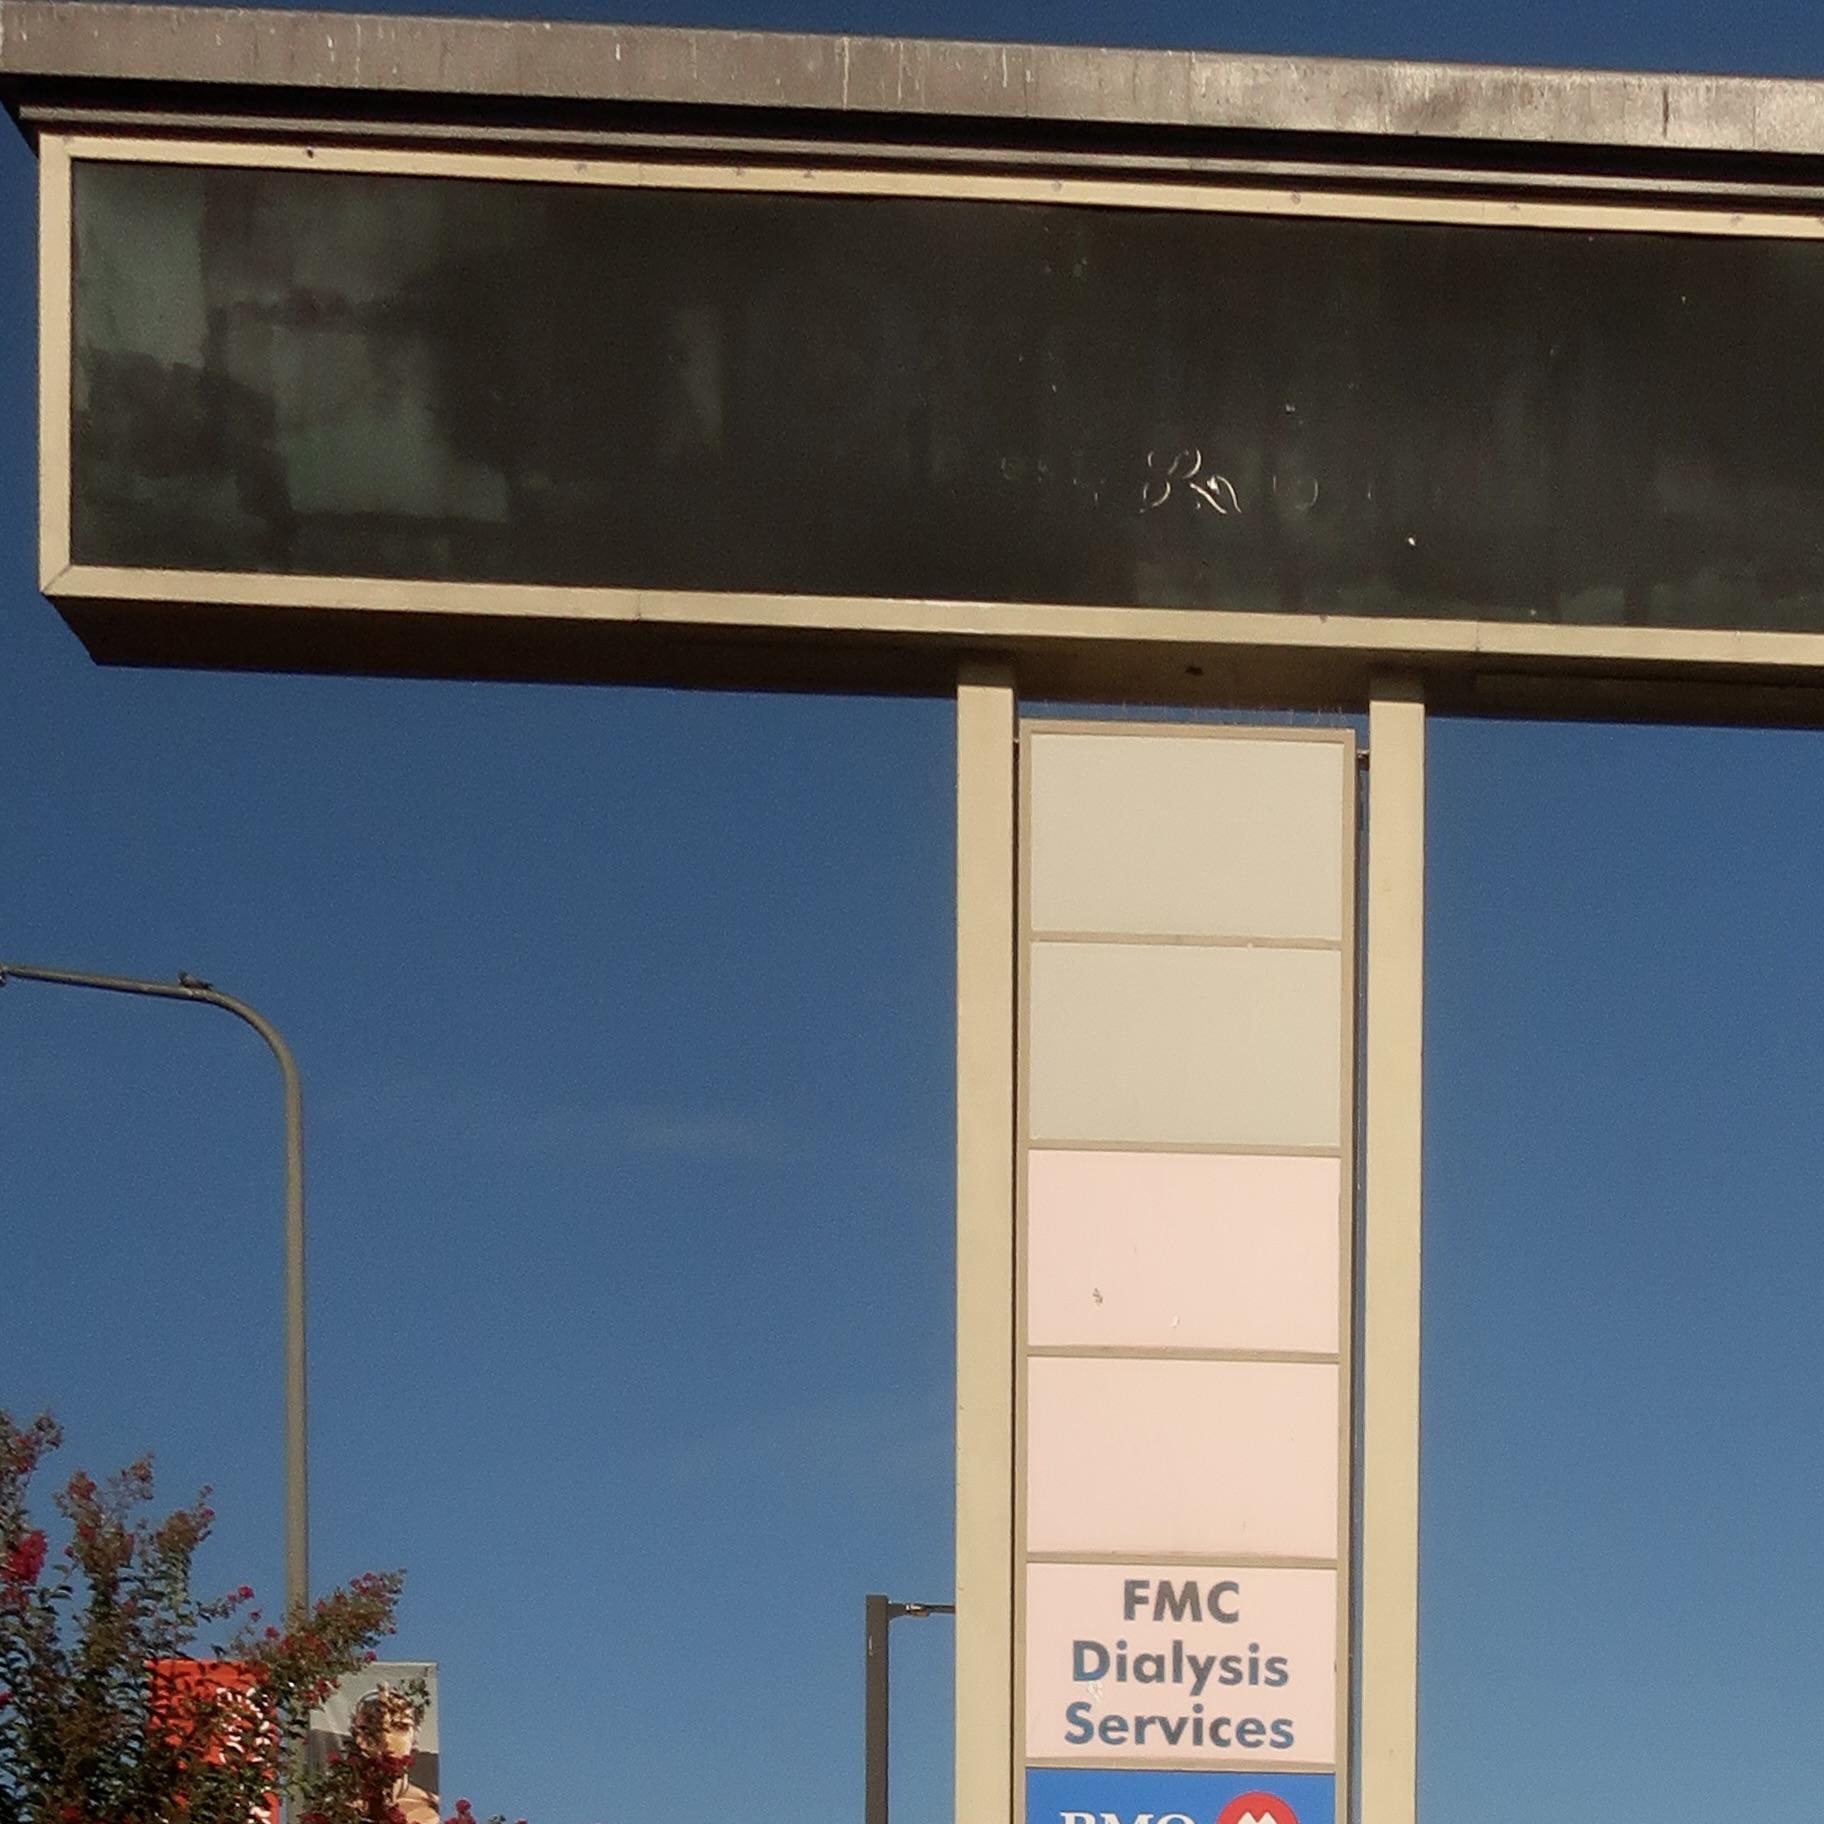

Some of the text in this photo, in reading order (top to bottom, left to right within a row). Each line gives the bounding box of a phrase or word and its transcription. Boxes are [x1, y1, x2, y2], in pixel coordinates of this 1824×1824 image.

[1123, 1579, 1240, 1624] FMC
[1072, 1639, 1289, 1697] Dialysis
[1064, 1701, 1295, 1749] Services
